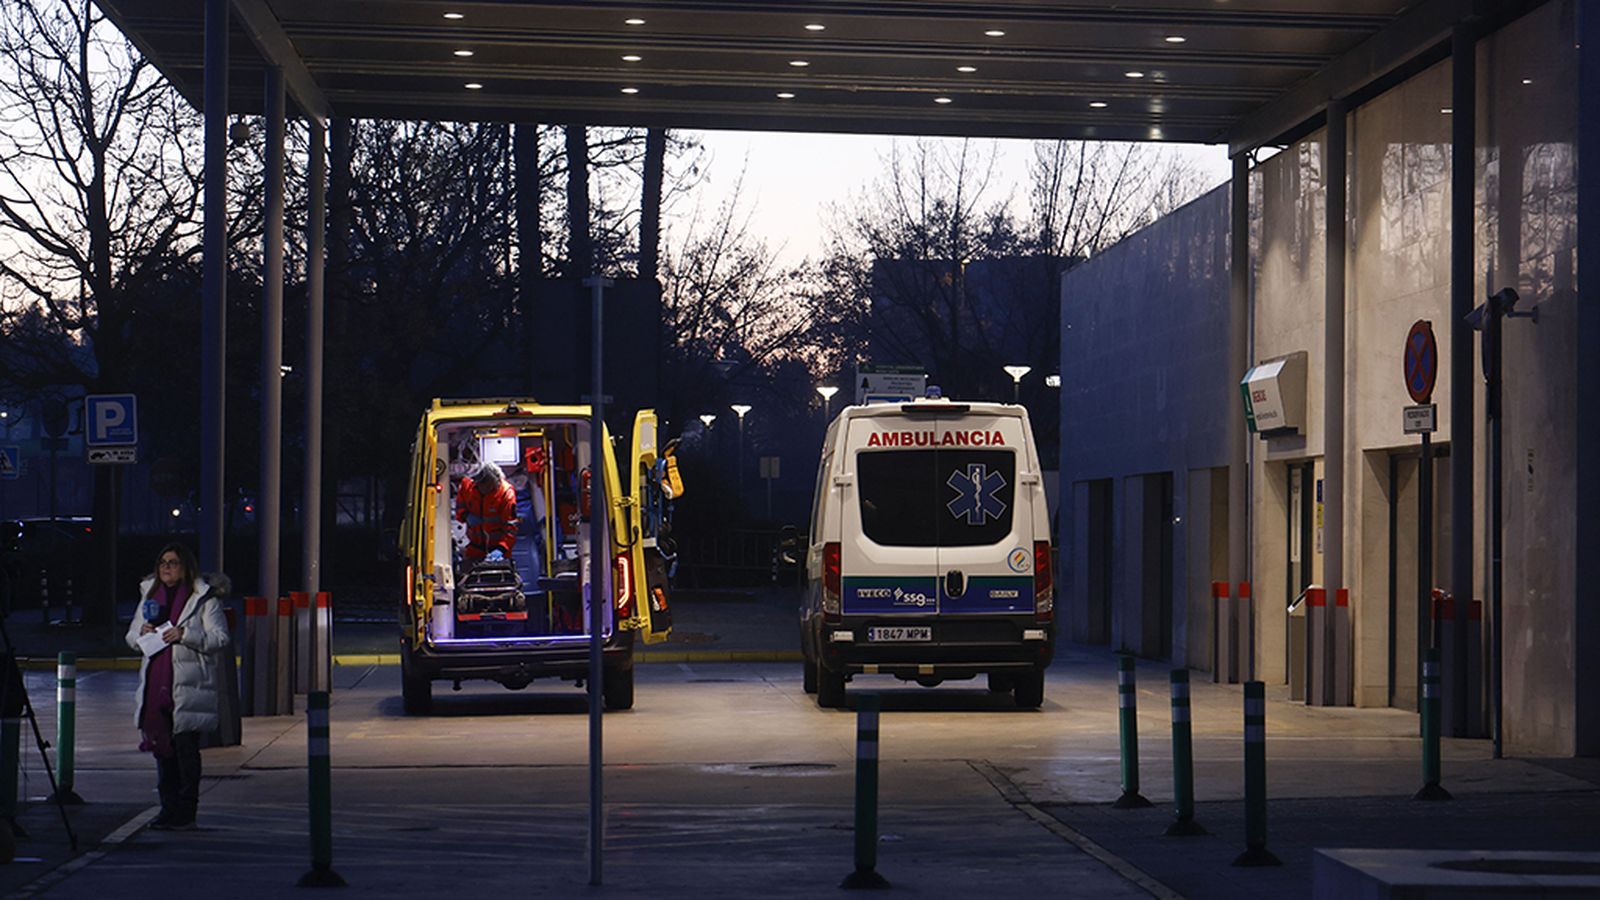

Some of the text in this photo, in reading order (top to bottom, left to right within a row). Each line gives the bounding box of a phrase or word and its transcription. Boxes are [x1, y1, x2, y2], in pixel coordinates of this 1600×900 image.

[96, 401, 126, 439] P
[867, 430, 1005, 447] AMBULANCIA
[857, 588, 892, 598] IVECO
[877, 628, 928, 640] 1847 MPM
